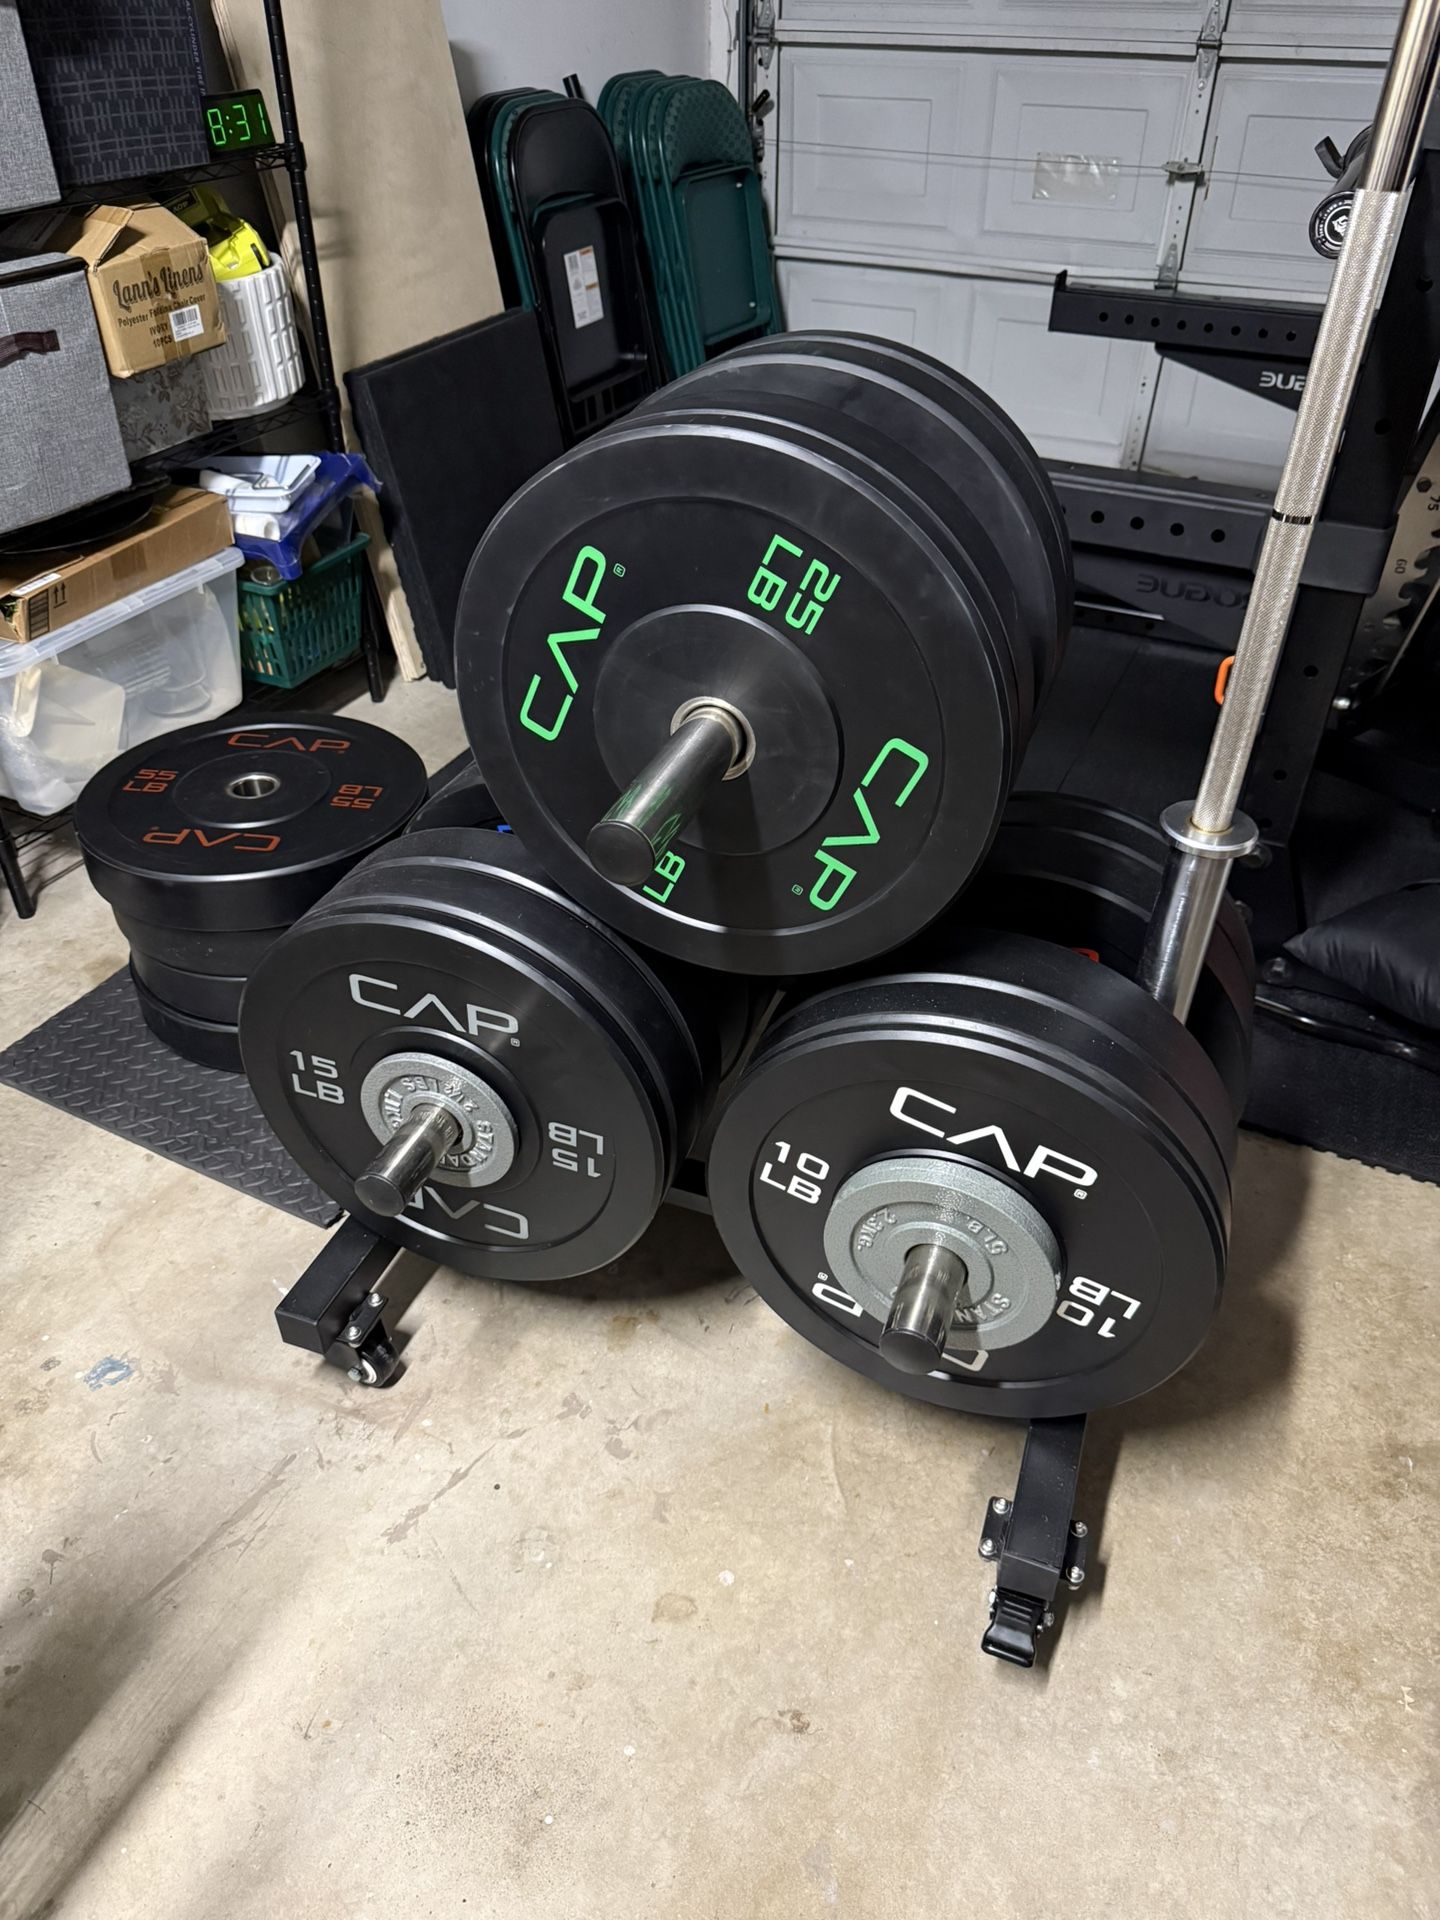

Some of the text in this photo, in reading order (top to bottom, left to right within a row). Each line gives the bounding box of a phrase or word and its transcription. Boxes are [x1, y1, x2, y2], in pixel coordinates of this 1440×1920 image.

[207, 103, 267, 145] 8:31
[160, 263, 204, 299] Linens
[118, 313, 149, 328] Polyester
[149, 303, 173, 318] Folding
[188, 293, 206, 306] Cover
[149, 322, 168, 336] IVORY
[747, 533, 804, 611] LB
[785, 558, 841, 635] 25
[519, 545, 607, 741] CAP
[227, 733, 351, 752] CAP
[122, 780, 169, 793] LB
[134, 768, 178, 781] 55
[338, 784, 384, 797] LB
[329, 796, 375, 810] 55
[142, 828, 281, 852] CAP
[809, 737, 929, 911] CAP
[643, 850, 686, 903] LB
[349, 974, 520, 1036] CAP
[289, 1050, 339, 1079] 15
[291, 1073, 345, 1105] LB
[548, 1121, 604, 1155] LB
[889, 1086, 1098, 1187] CAP
[552, 1148, 601, 1178] 15
[774, 1140, 829, 1181] 10
[759, 1162, 822, 1205] LB
[408, 1186, 529, 1239] CA
[951, 1293, 1013, 1322] STAN
[1068, 1276, 1142, 1320] LB
[1056, 1300, 1116, 1339] 10
